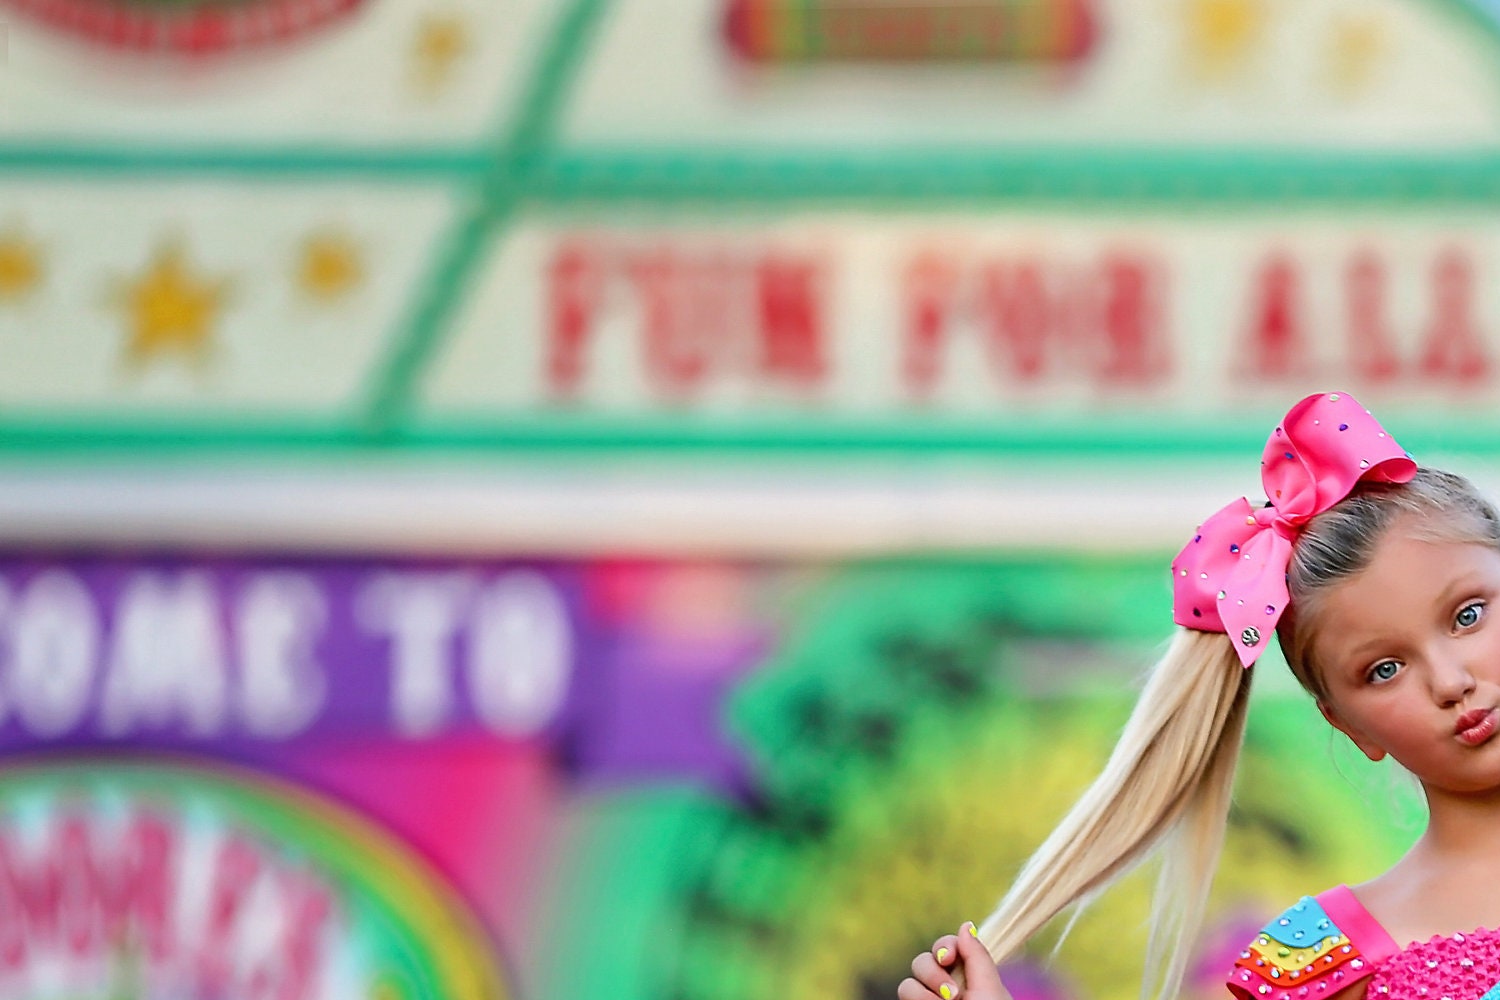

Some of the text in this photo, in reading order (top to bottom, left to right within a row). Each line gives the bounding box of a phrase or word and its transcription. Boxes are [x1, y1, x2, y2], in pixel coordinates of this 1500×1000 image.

[543, 238, 830, 402] FUN
[895, 242, 1175, 395] FOR
[352, 568, 574, 738] TO
